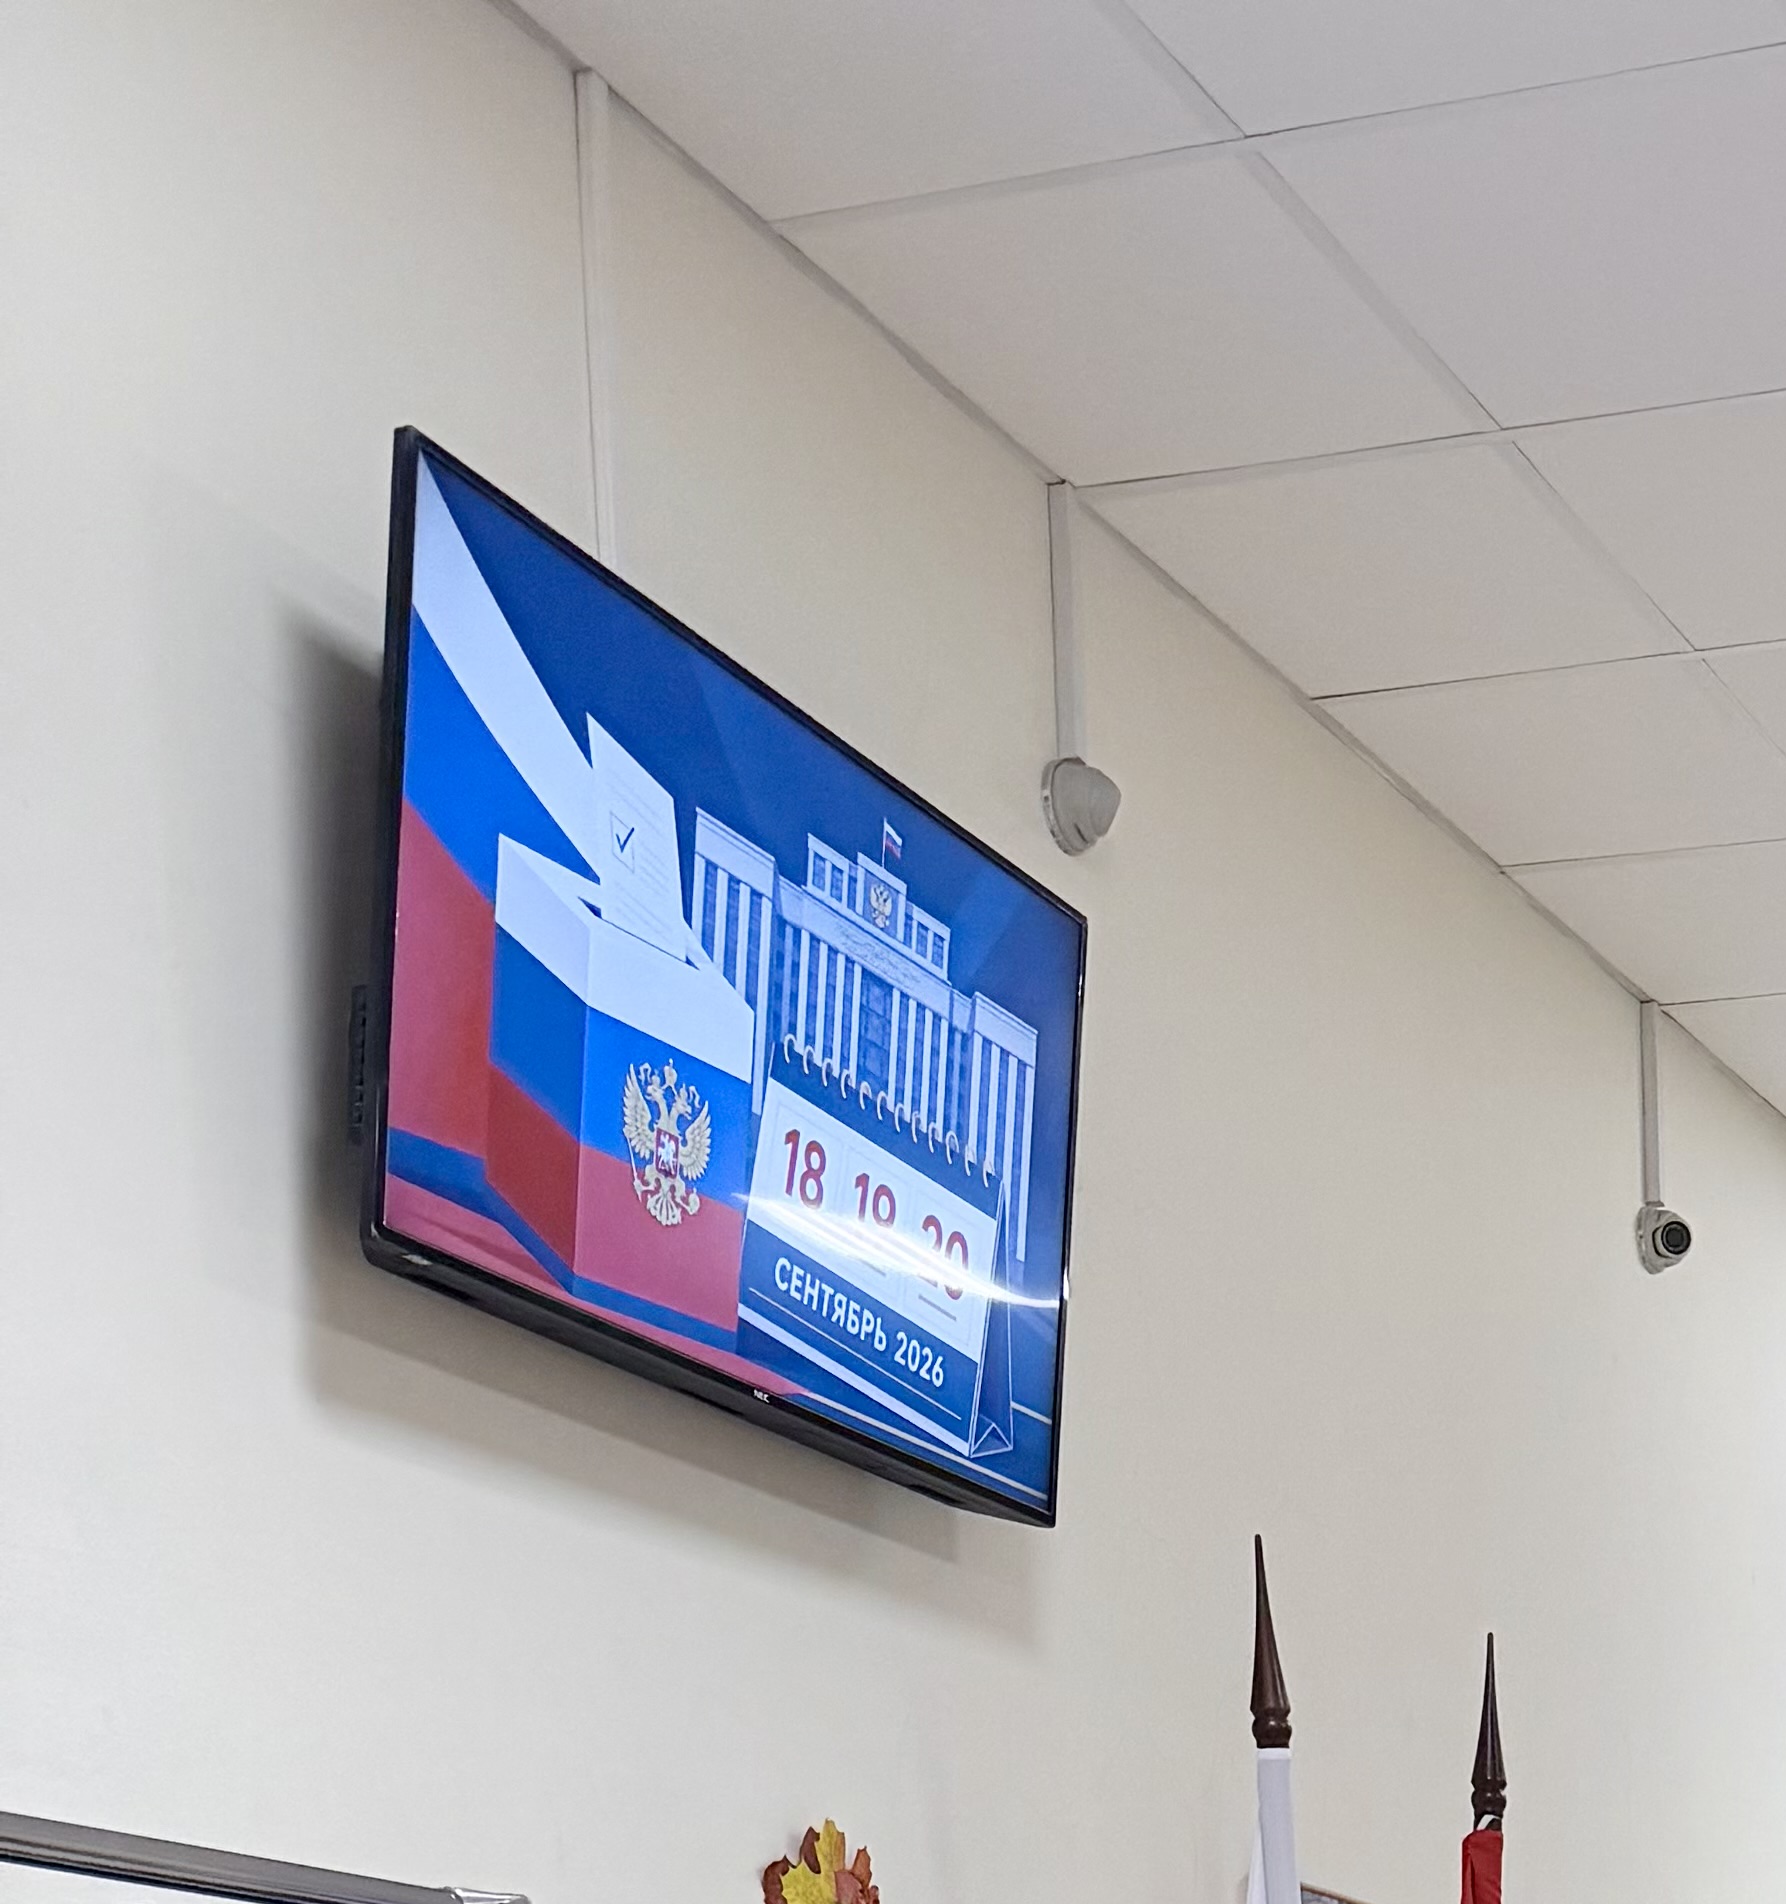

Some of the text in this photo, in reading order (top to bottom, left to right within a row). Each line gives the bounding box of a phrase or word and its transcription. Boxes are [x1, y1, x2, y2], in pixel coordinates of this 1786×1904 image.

[784, 1128, 827, 1211] 18
[921, 1214, 969, 1300] 20
[774, 1256, 945, 1388] СЕНТЯБРЬ 2026
